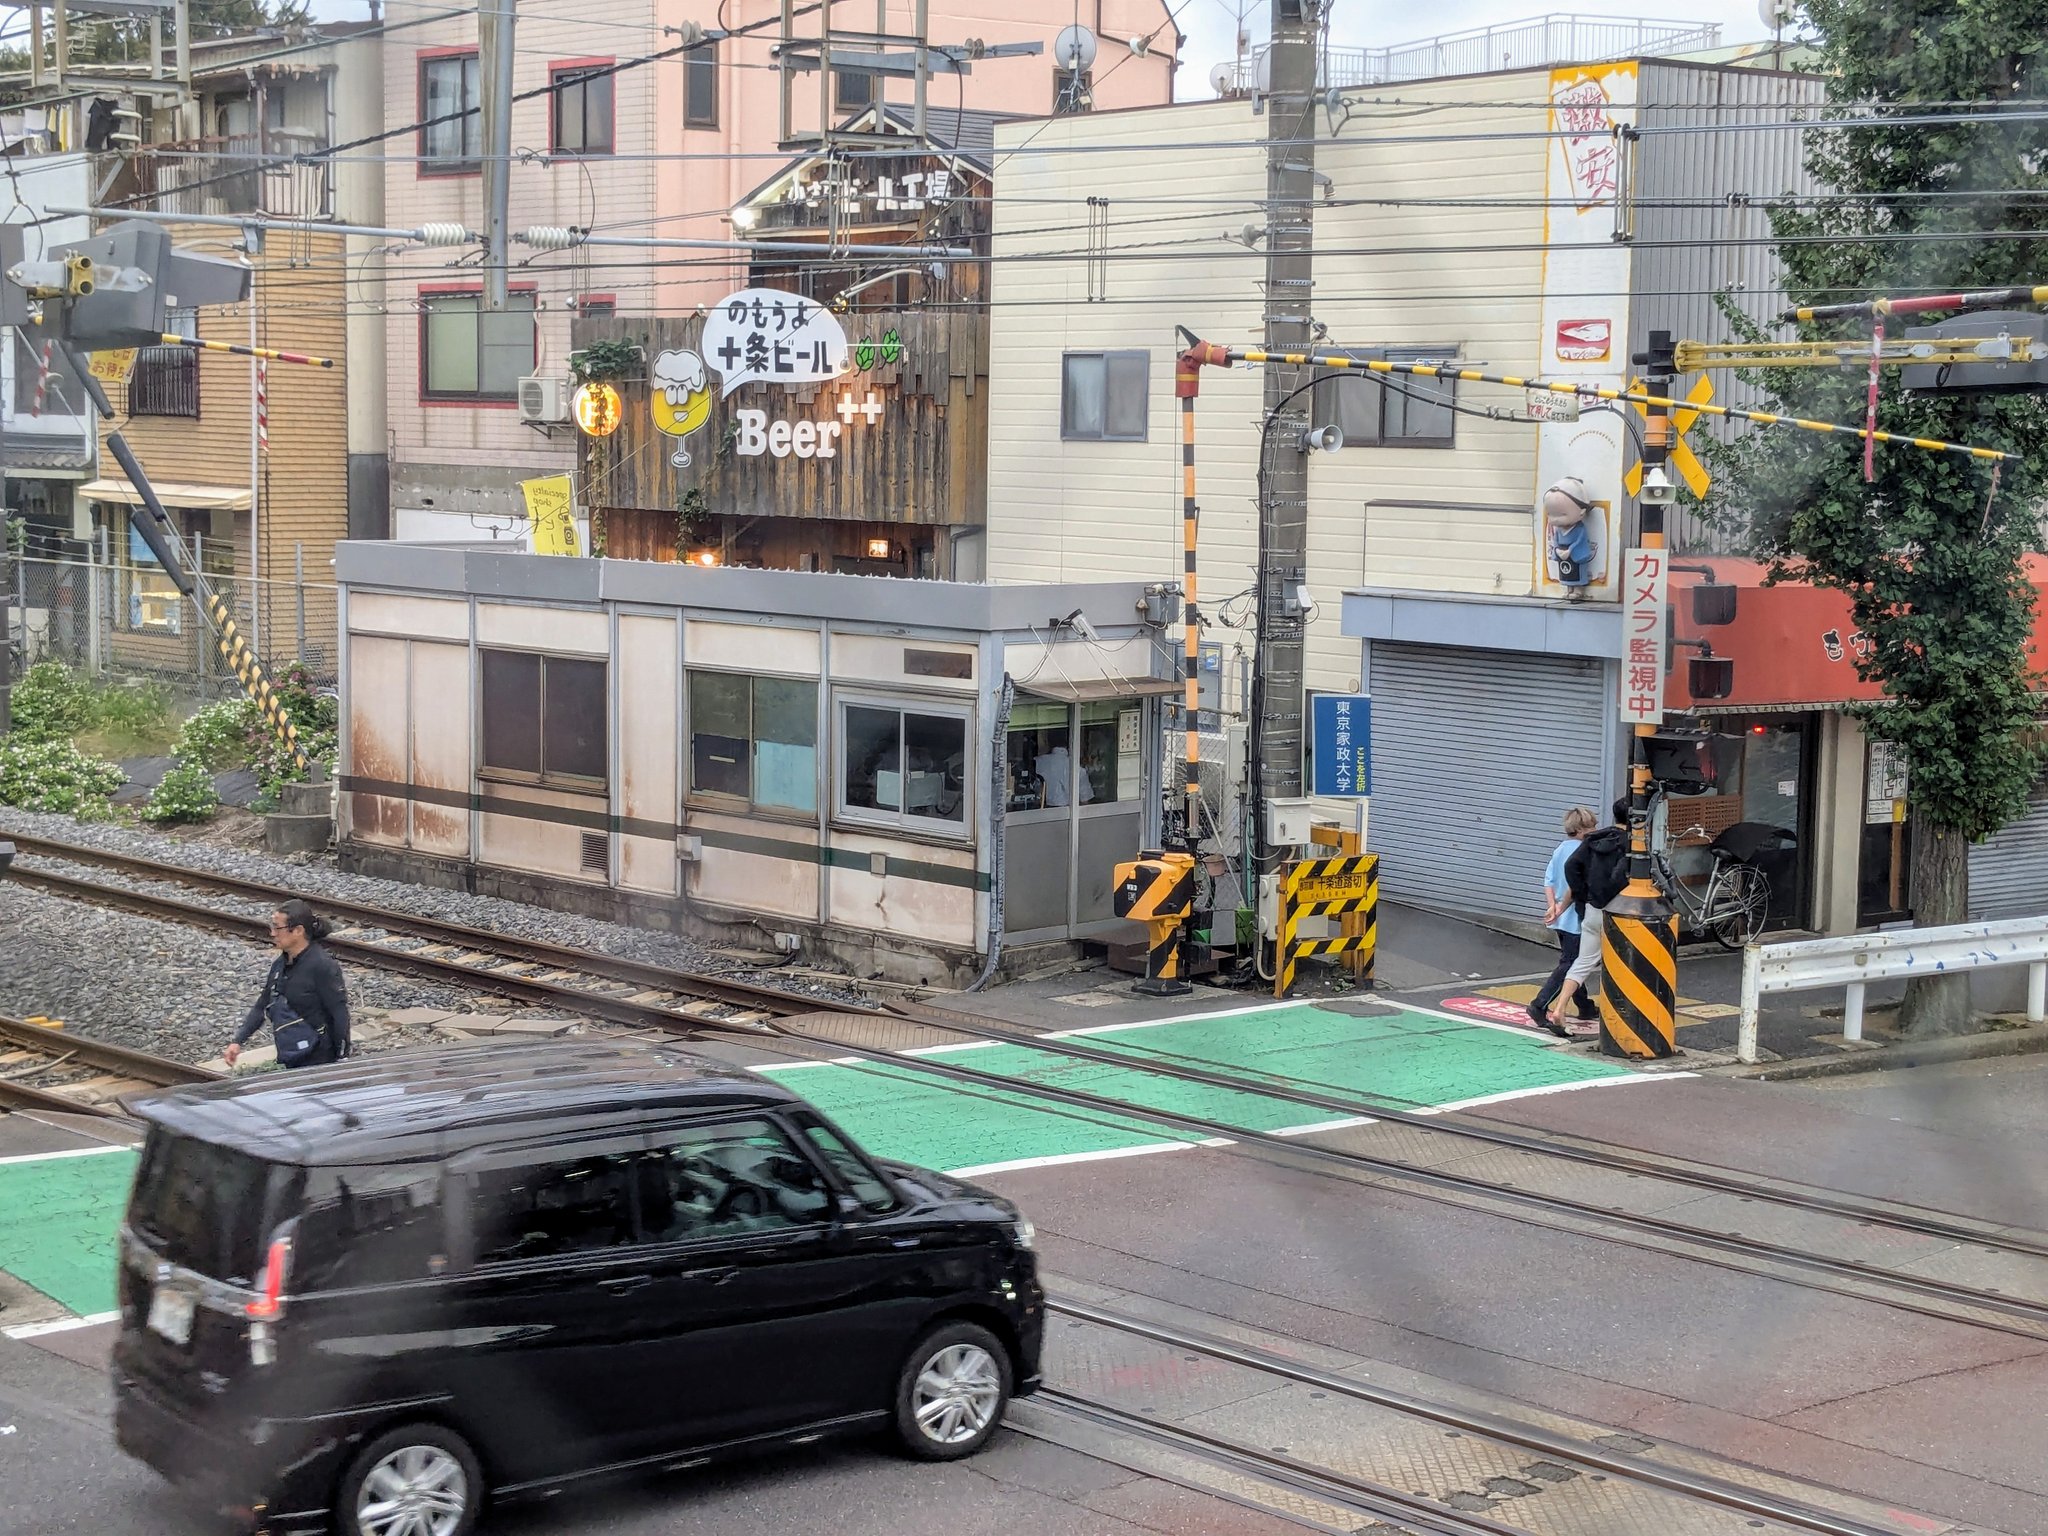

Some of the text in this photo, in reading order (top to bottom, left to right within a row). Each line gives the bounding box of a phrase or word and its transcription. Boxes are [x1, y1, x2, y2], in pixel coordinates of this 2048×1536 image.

[728, 297, 809, 332] のもうよ
[718, 332, 833, 374] 十条ビール
[1628, 554, 1659, 719] カメラ監視中
[1336, 701, 1351, 792] 東京家政大学
[1356, 746, 1365, 793] ここを左折
[1318, 875, 1362, 891] 十条道踏切
